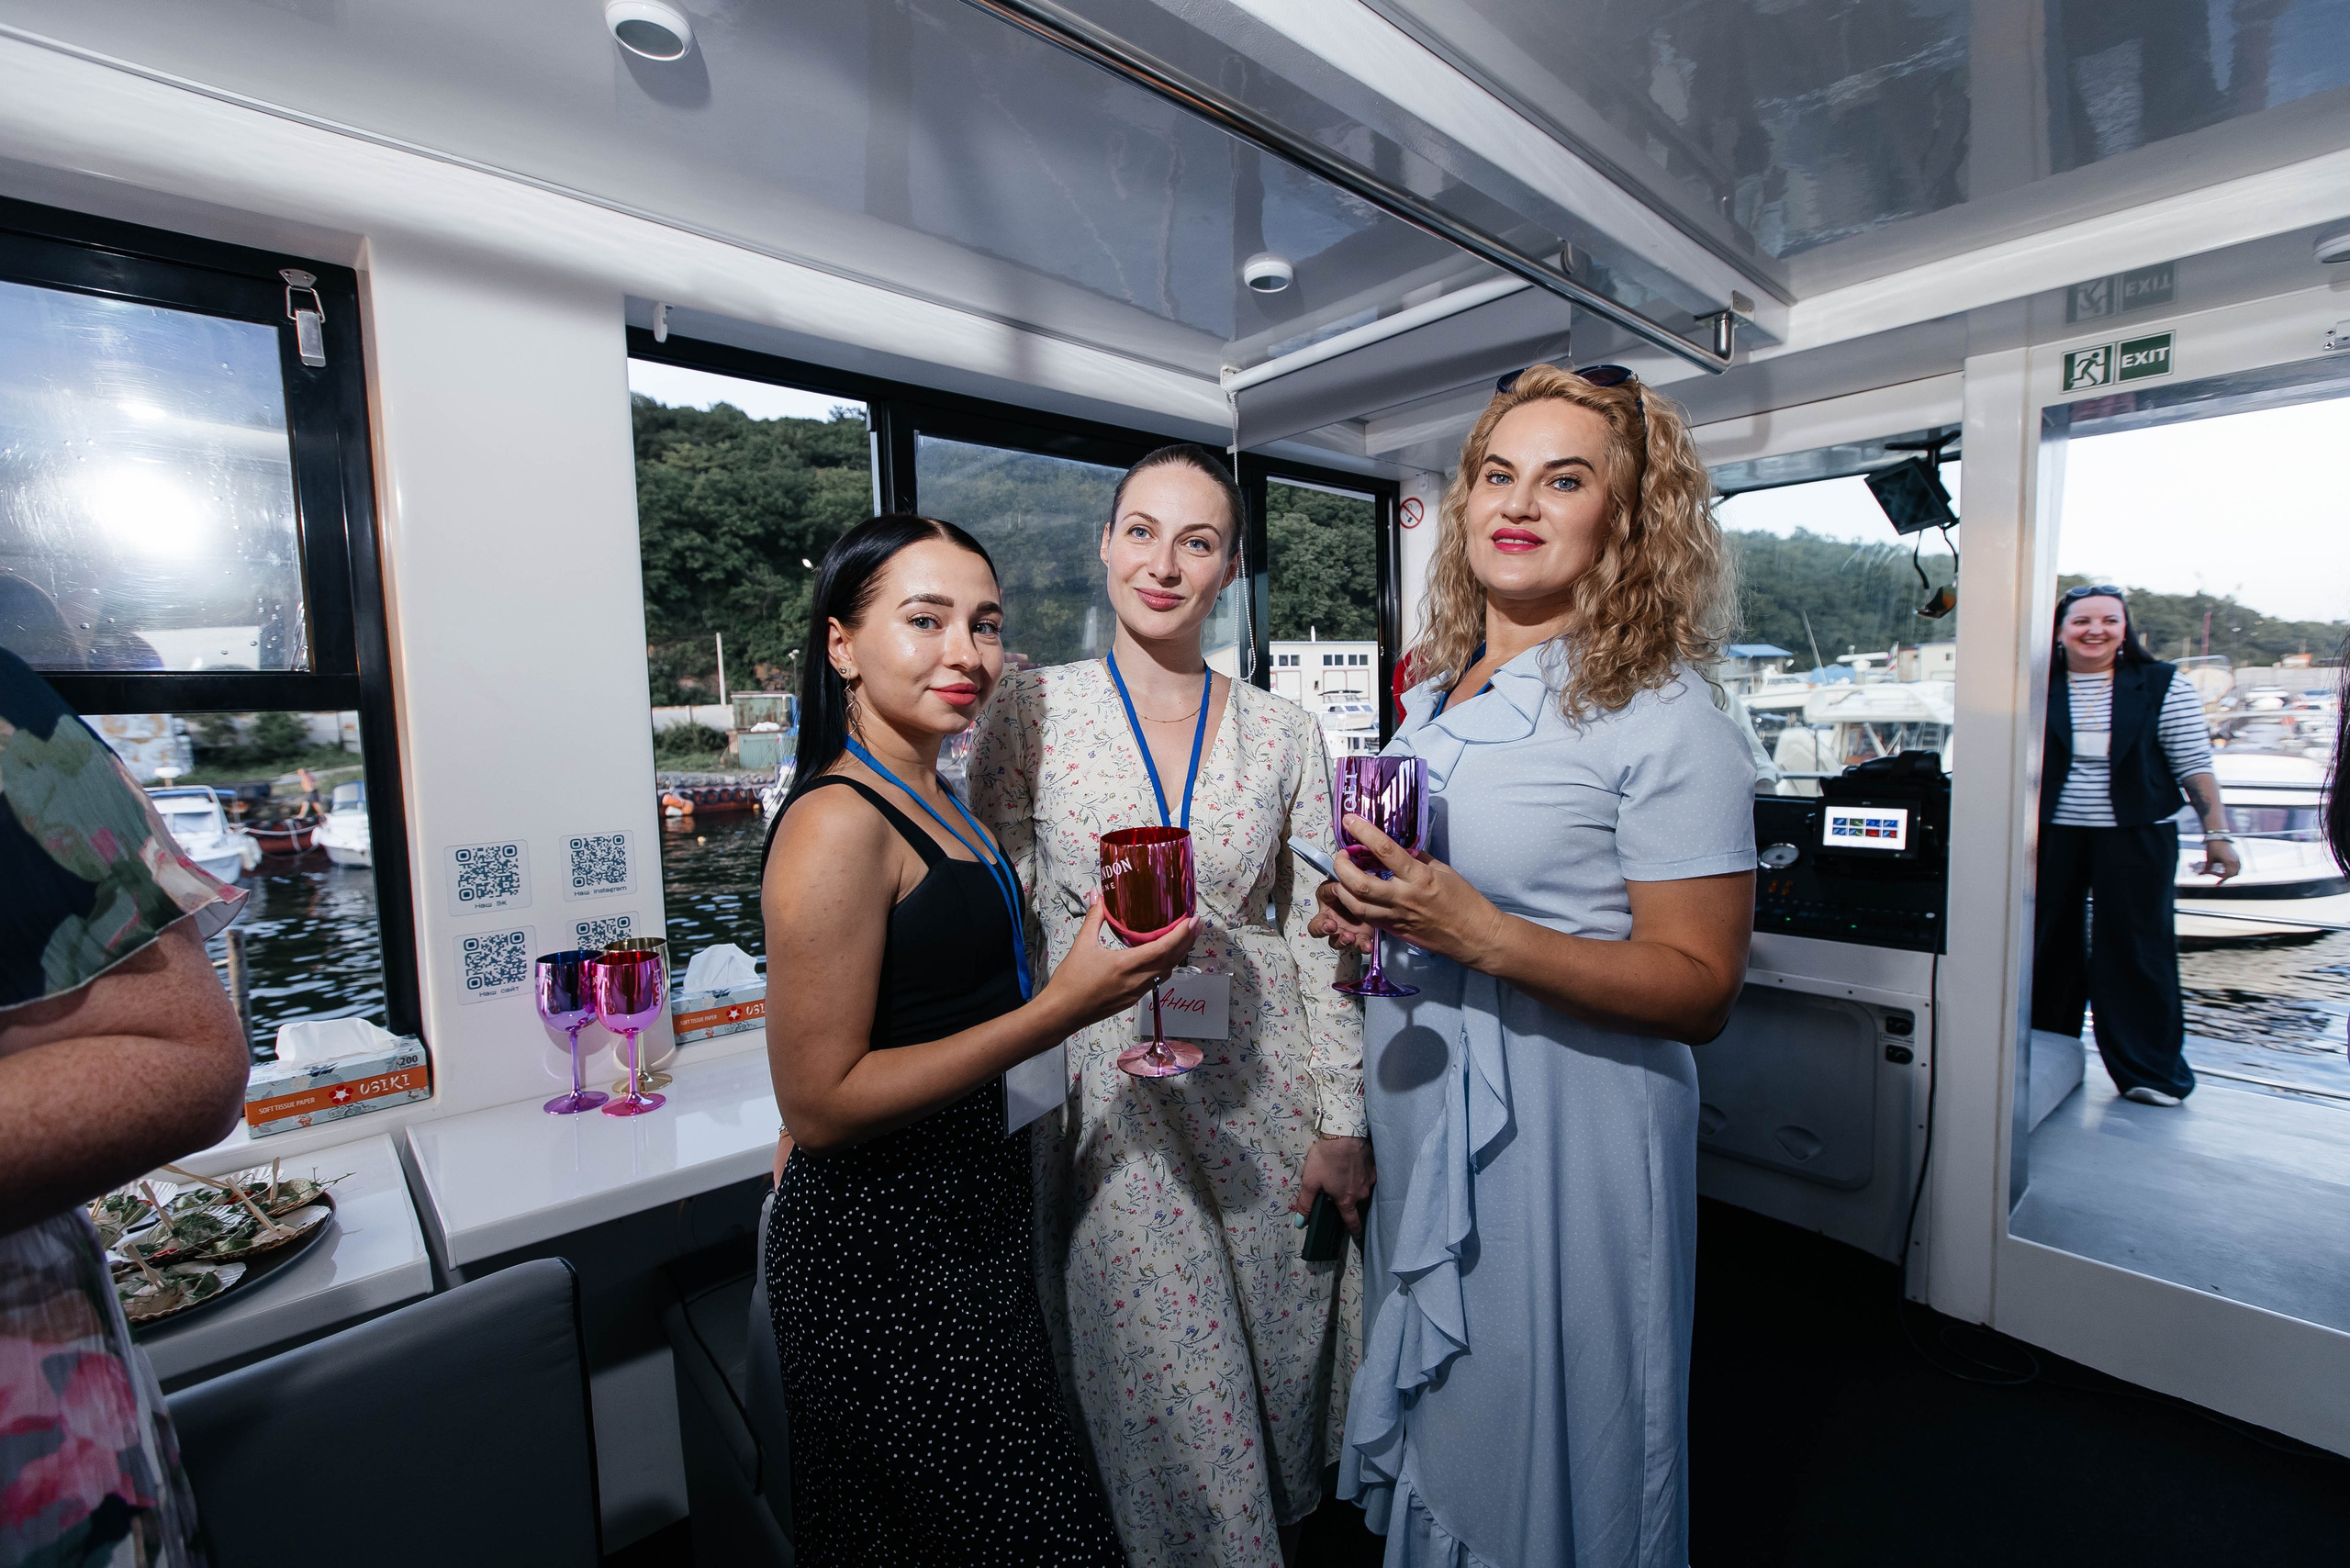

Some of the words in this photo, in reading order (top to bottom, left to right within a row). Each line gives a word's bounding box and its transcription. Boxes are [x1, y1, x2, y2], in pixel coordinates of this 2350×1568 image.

[2121, 346, 2170, 369] EXIT
[1342, 769, 1359, 812] OËT
[593, 885, 628, 895] Instagram
[478, 990, 497, 998] Наш
[500, 985, 520, 995] сайт
[745, 1002, 766, 1015] USI
[1148, 987, 1206, 1016] Анна
[679, 1018, 691, 1026] SOFT
[690, 1016, 704, 1025] TISSUE
[704, 1014, 718, 1022] PAPER
[399, 1055, 419, 1066] 200
[359, 1073, 411, 1095] USIKI
[258, 1105, 274, 1114] SOFT
[274, 1101, 296, 1111] TISSUE
[296, 1097, 316, 1107] PAPER
